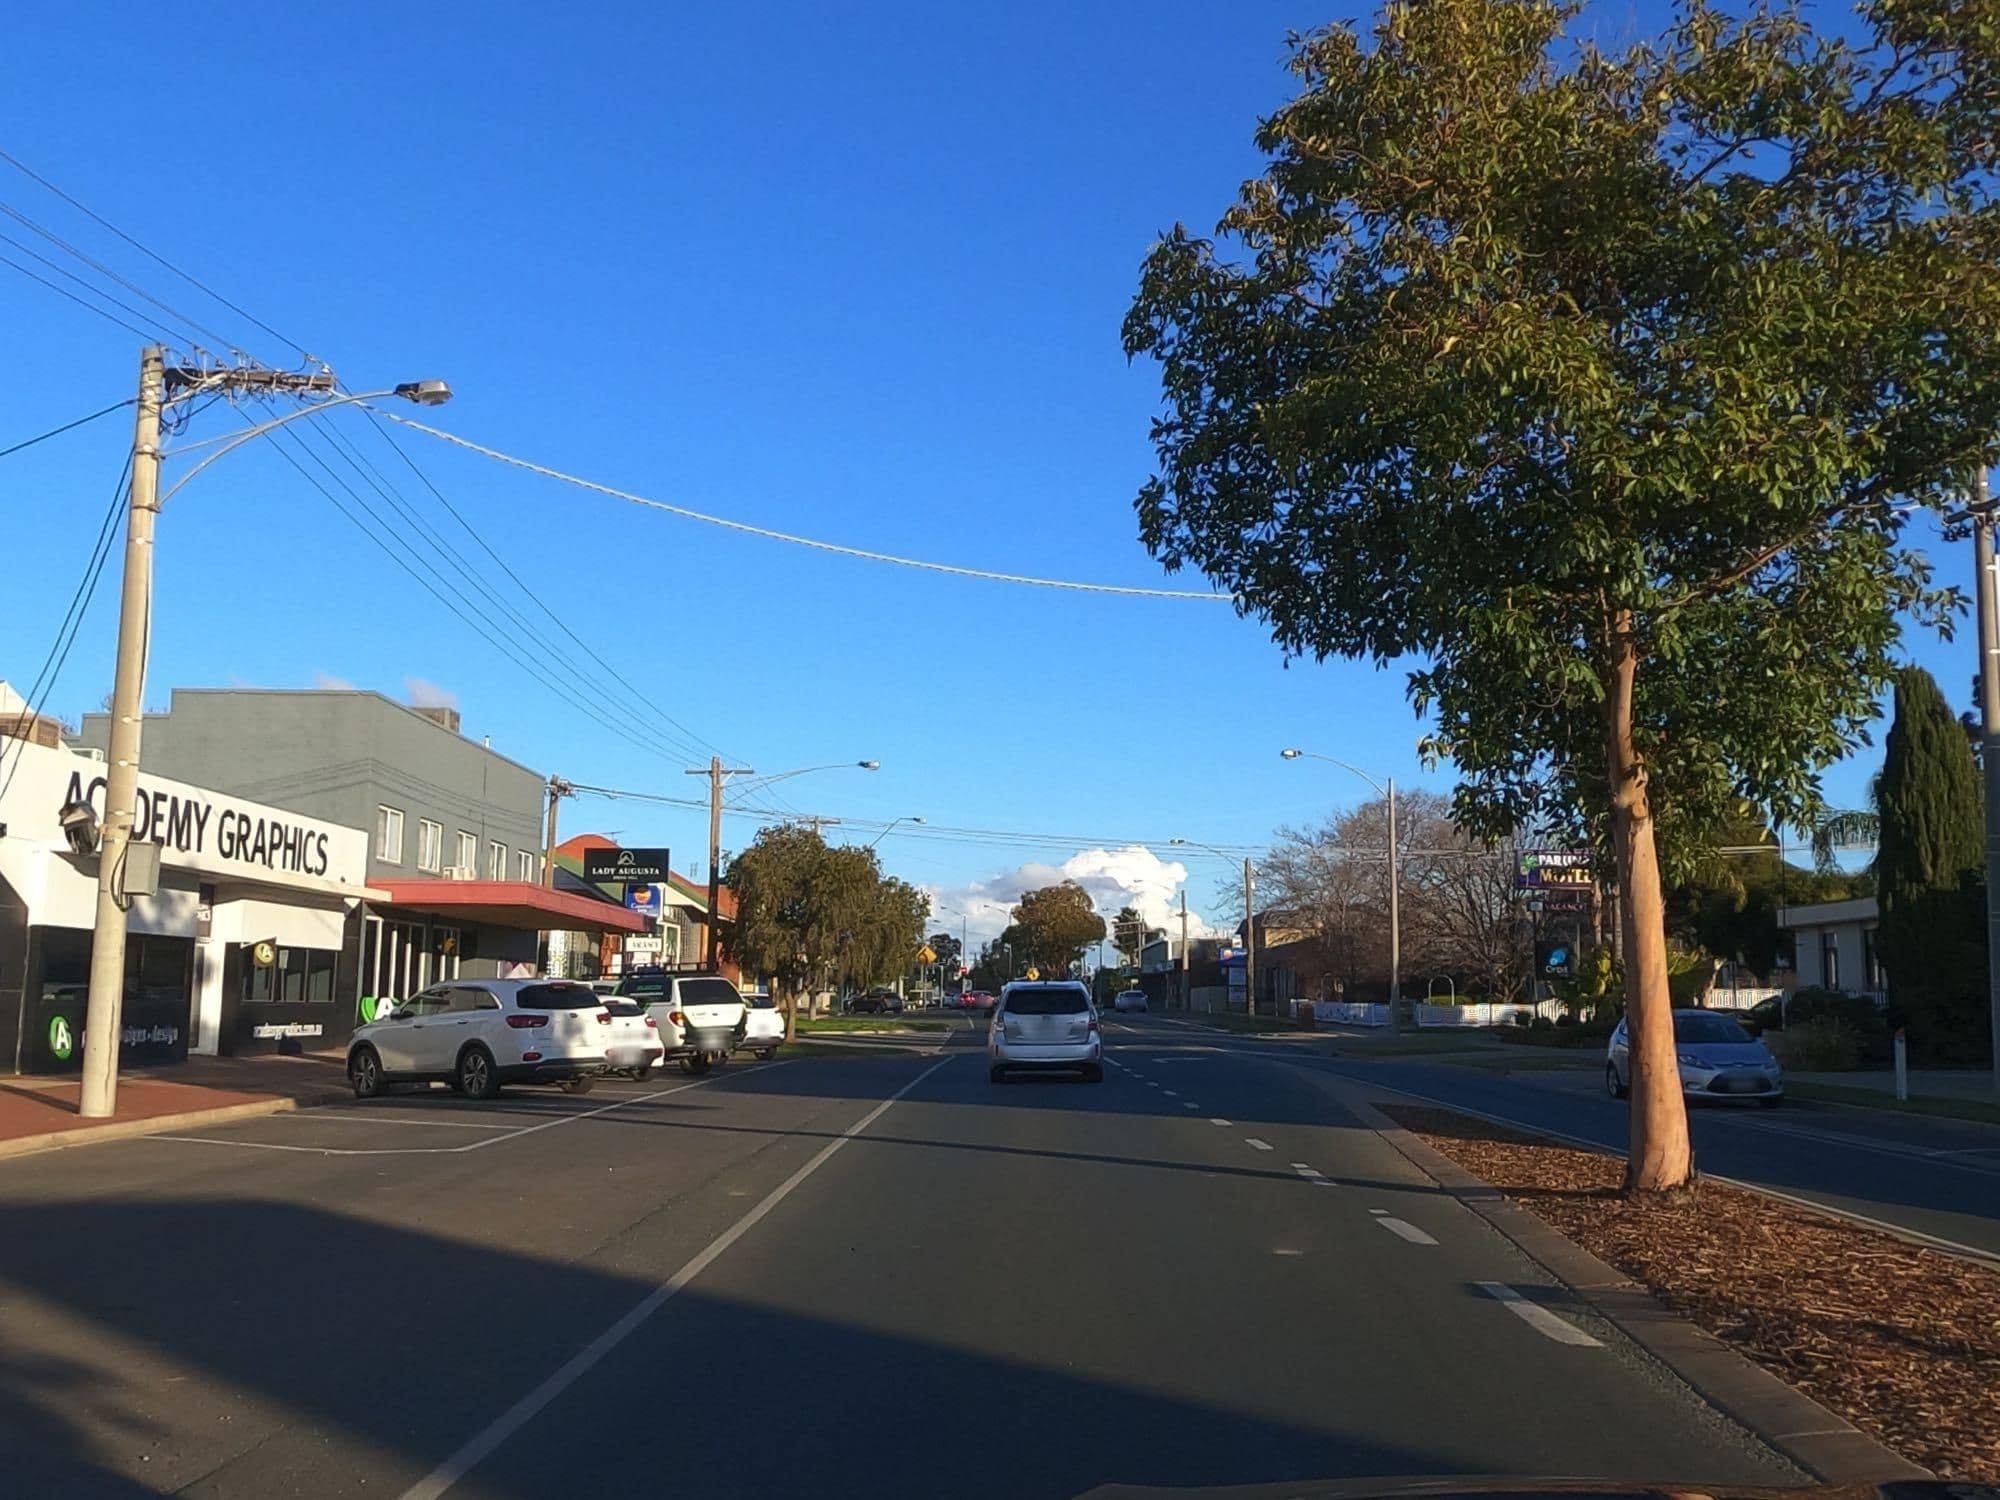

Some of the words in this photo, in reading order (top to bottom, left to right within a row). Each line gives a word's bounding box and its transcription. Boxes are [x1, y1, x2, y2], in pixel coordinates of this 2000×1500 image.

[64, 771, 212, 852] ACDEMY
[217, 809, 329, 877] GRAPHICS
[592, 867, 616, 875] LADY
[618, 867, 660, 875] AUGUSTA
[1540, 868, 1592, 883] MOTEL
